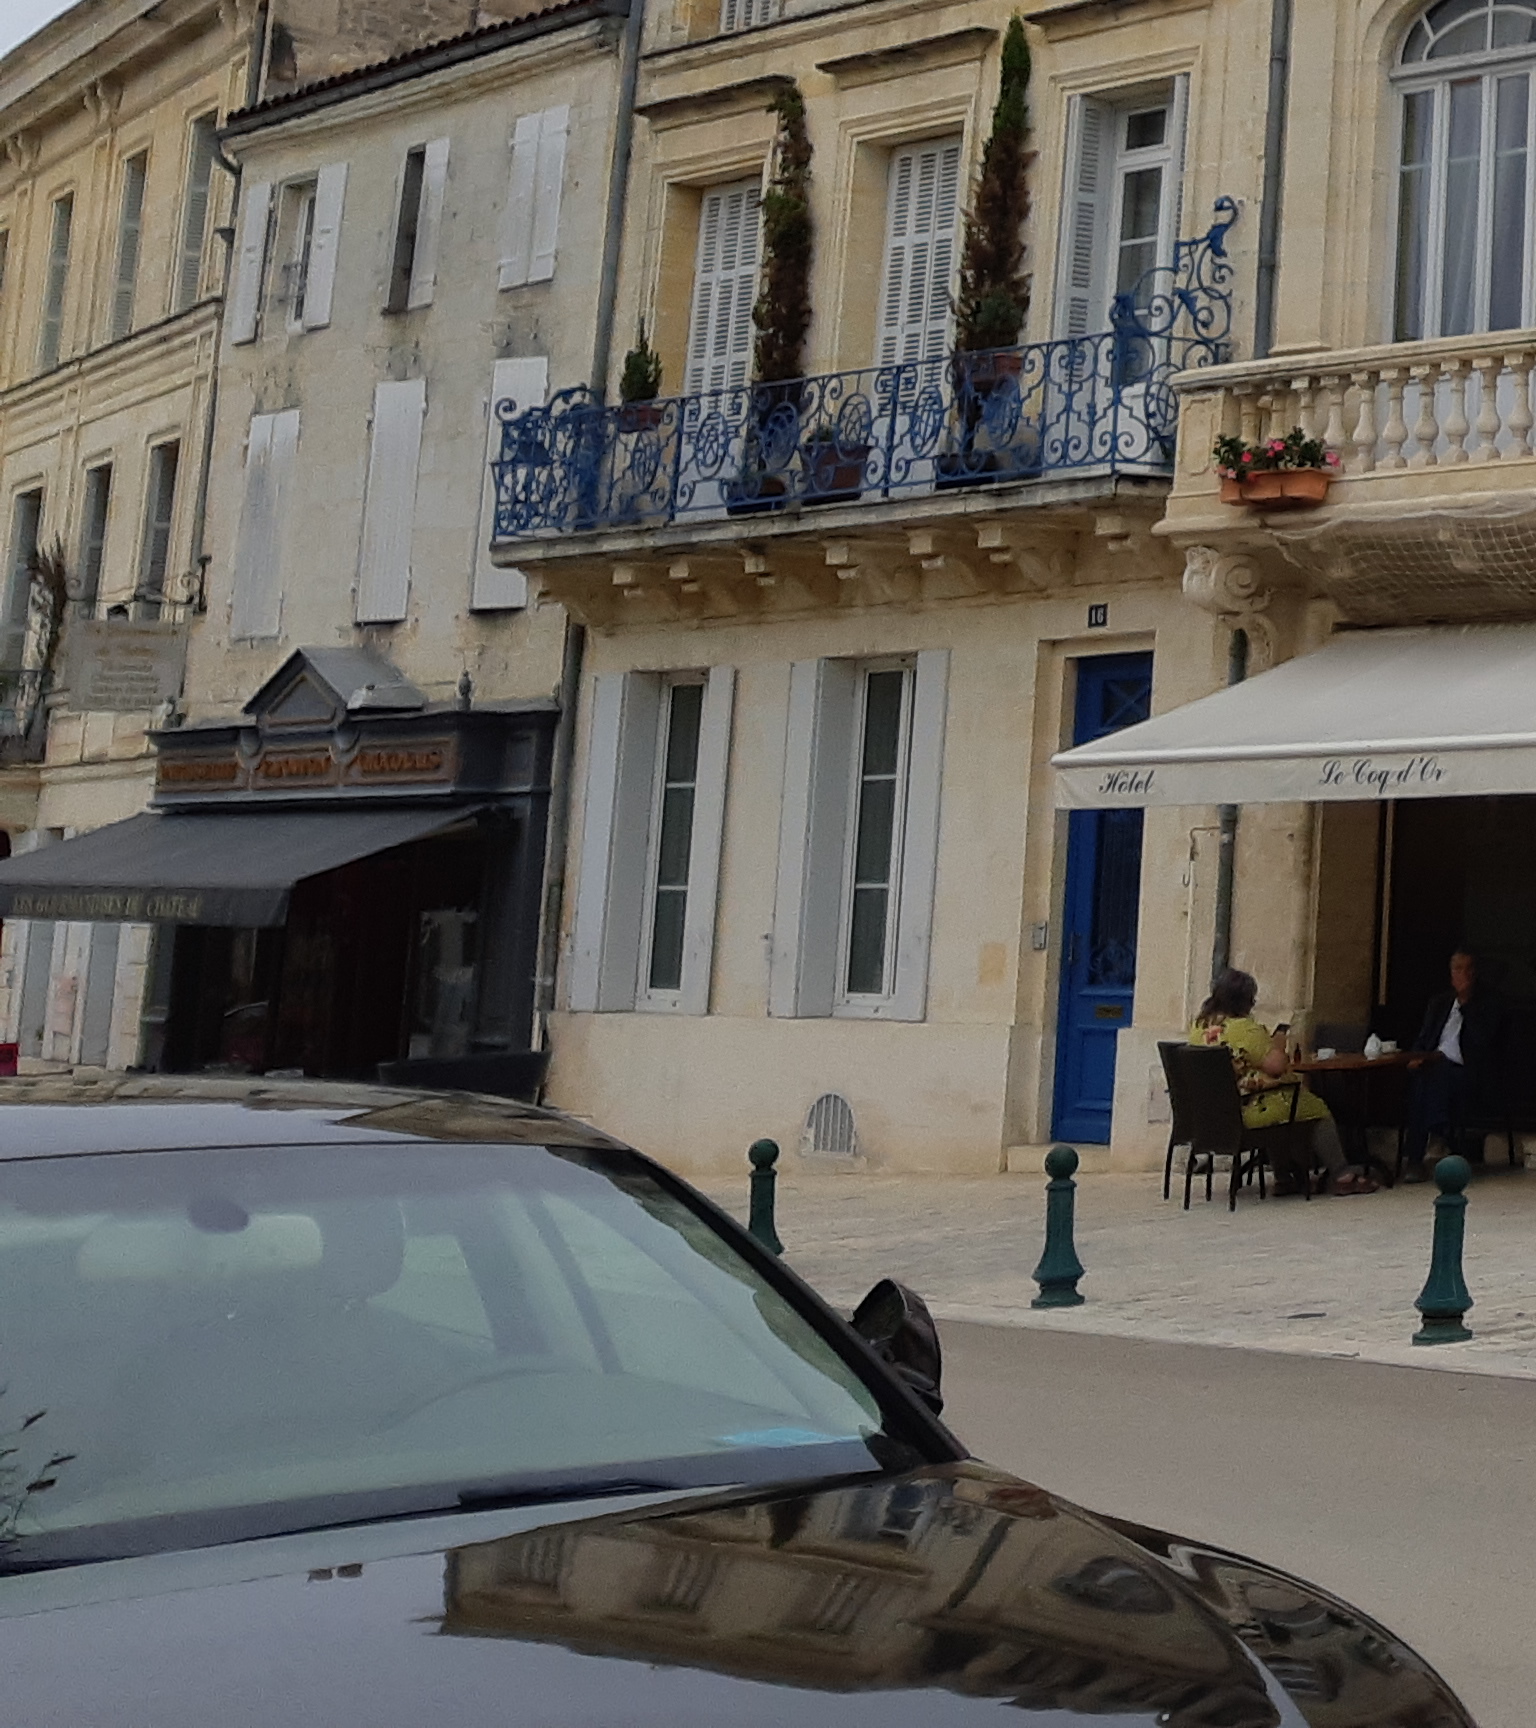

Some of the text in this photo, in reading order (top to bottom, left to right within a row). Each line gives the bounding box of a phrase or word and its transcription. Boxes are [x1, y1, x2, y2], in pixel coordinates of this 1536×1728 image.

[1099, 770, 1156, 794] Hôtel
[1318, 755, 1446, 794] Le Coq d'Or
